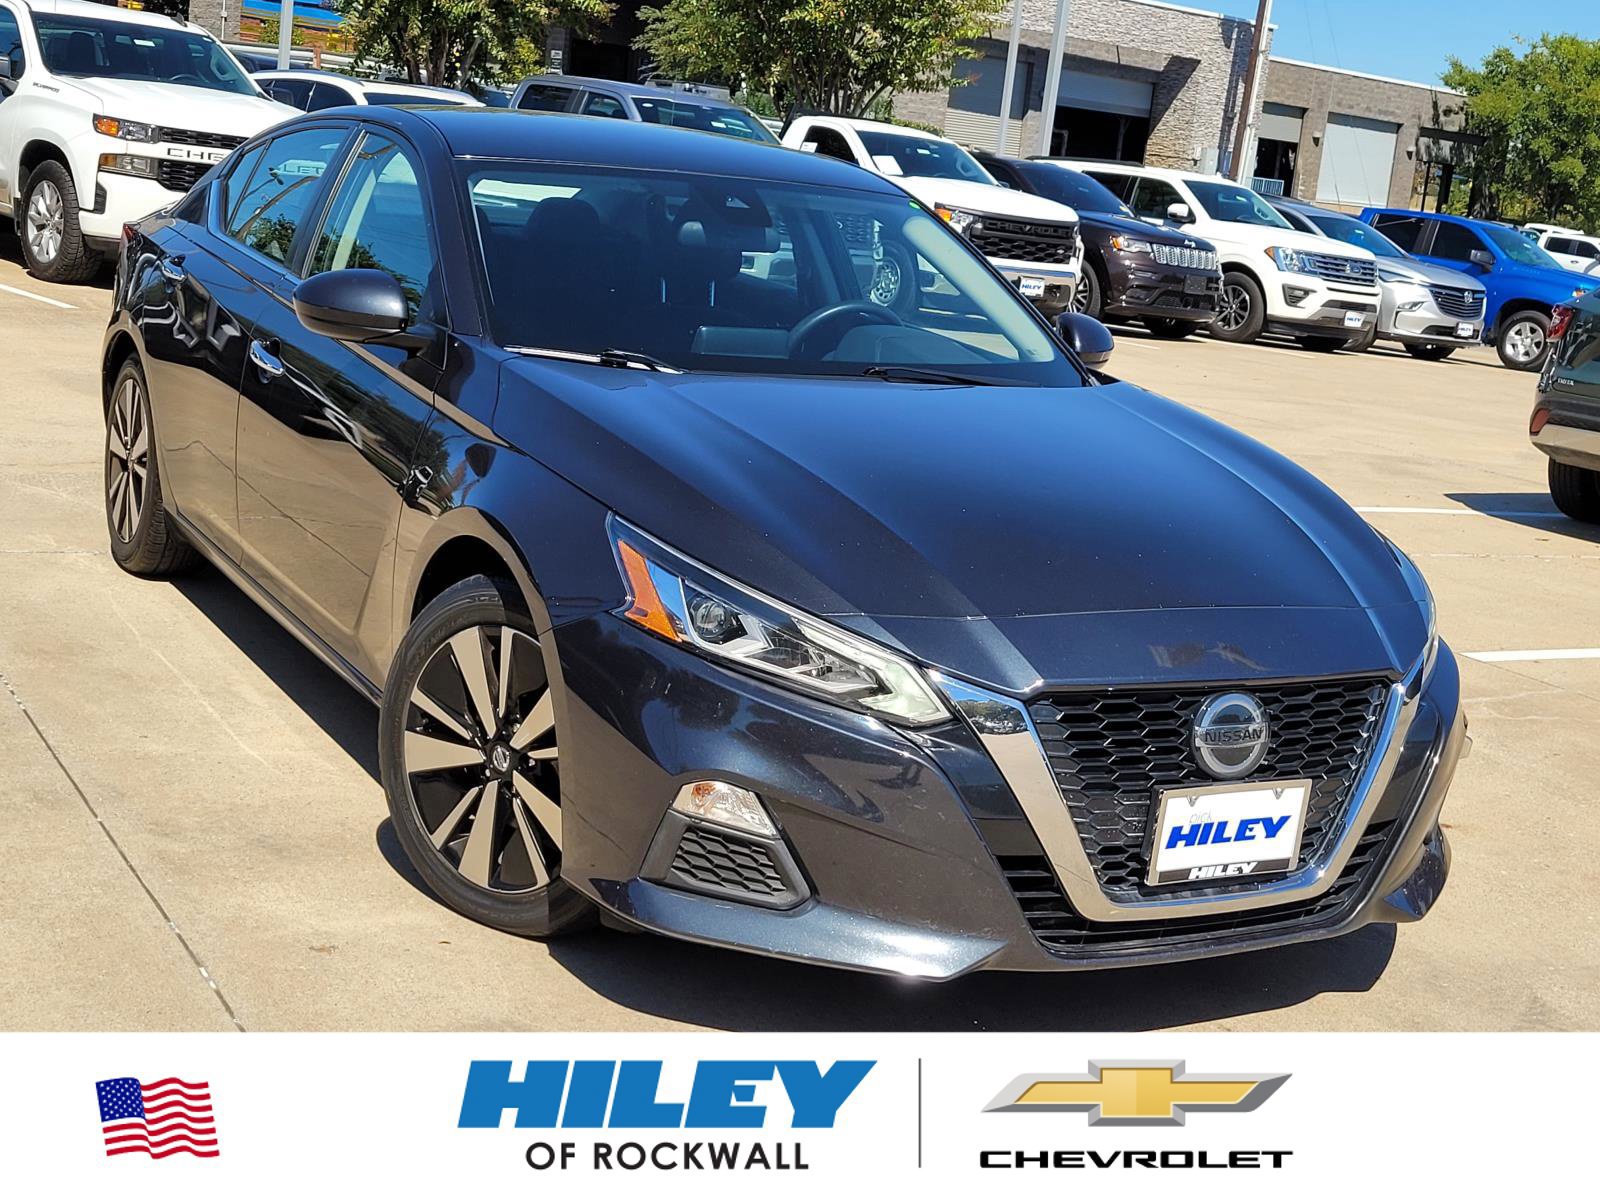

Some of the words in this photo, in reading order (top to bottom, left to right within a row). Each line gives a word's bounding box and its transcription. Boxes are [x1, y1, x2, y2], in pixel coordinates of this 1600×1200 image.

[1205, 727, 1263, 743] NISSAN
[1164, 815, 1291, 849] HILEY
[1188, 861, 1258, 880] HILEY
